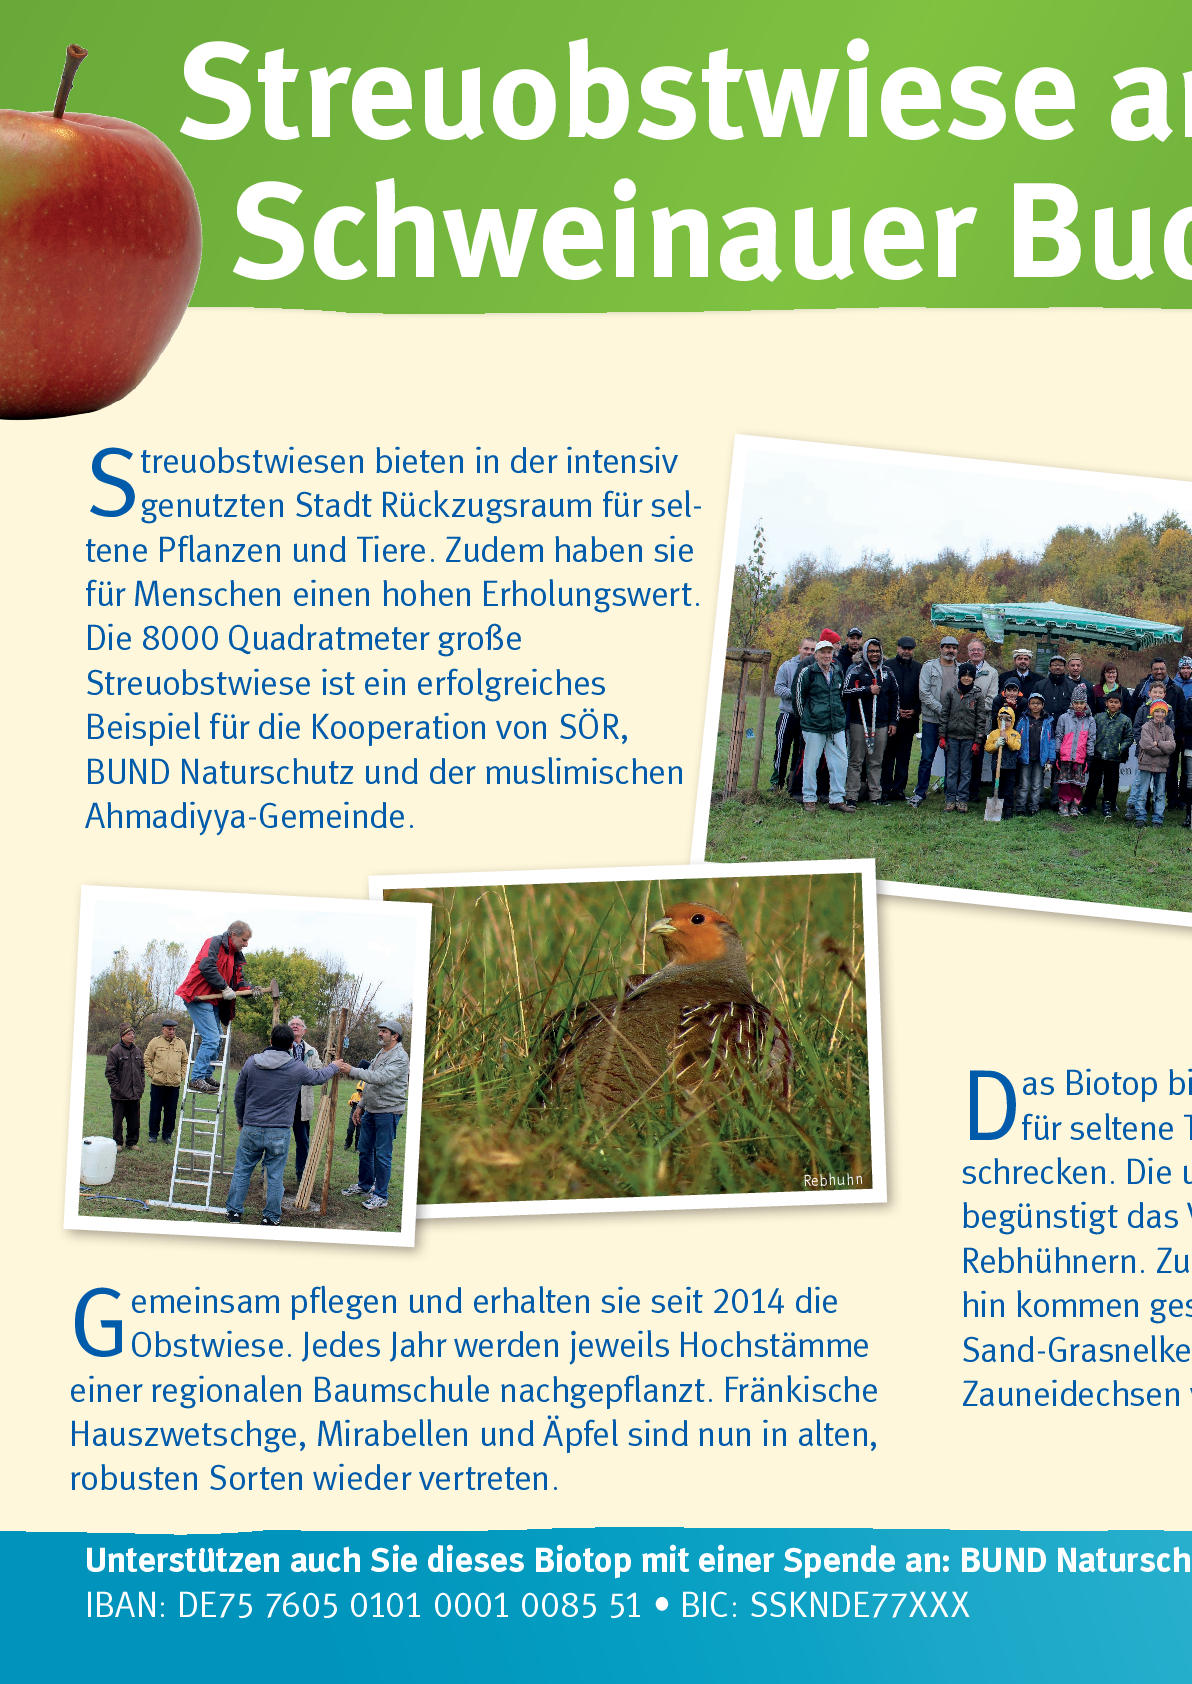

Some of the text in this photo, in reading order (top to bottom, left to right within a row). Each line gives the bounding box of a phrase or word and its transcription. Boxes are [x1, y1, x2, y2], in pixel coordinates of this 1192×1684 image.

[179, 37, 1076, 141] Streuobstwiese
[232, 177, 978, 282] Schweinauer
[87, 623, 522, 658] Die 8000 Quadratmeter große
[86, 667, 606, 703] Streuobstwiese ist ein erfolgreiches
[84, 801, 414, 836] Ahmadiyya-Gemeinde.
[804, 1173, 863, 1186] Rebhuhn
[963, 1246, 1145, 1274] Rebhühnern.
[963, 1290, 1005, 1318] hin
[1017, 1289, 1139, 1318] kommen
[70, 1374, 878, 1410] einer regionalen Baumschule nachgepflanzt. Fränkische
[962, 1379, 1180, 1407] Zauneidechsen
[70, 1463, 560, 1491] robusten Sorten wieder vertreten.
[86, 1547, 280, 1573] Unterstützen
[290, 1546, 361, 1573] auch
[370, 1544, 418, 1573] Sie
[427, 1544, 525, 1573] dieses
[535, 1544, 632, 1579] Biotop
[642, 1544, 690, 1573] mit
[698, 1544, 775, 1573] einer
[783, 1544, 896, 1579] Spende
[905, 1552, 950, 1573] an:
[961, 1547, 1047, 1573] BUND
[87, 1591, 970, 1619] IBAN: DE75 7605 0101 0001 0085 51 BIC: SSKNDE77XXX
